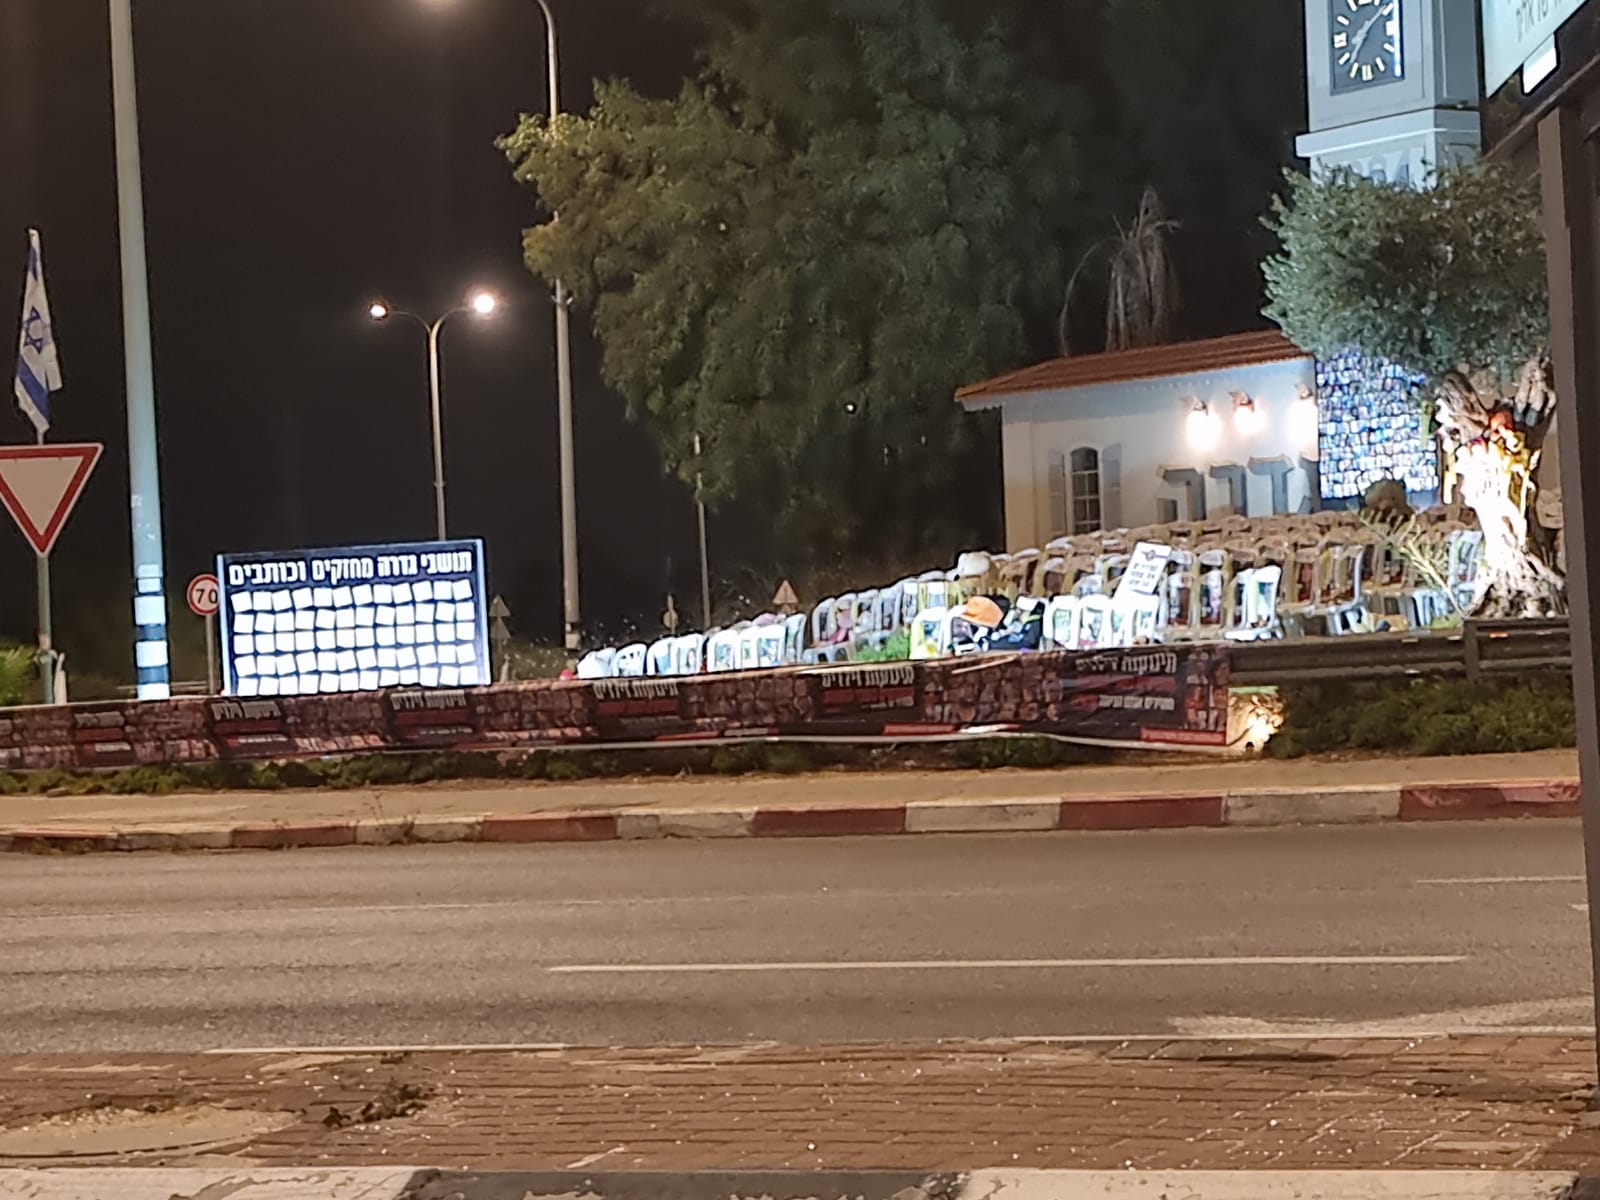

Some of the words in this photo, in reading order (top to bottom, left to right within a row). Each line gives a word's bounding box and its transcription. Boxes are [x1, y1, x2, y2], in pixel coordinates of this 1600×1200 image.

[228, 560, 307, 586] וכותבים
[311, 557, 374, 586] מחזקים
[377, 554, 418, 577] גדרה
[420, 551, 472, 575] תושבי
[195, 588, 218, 604] 70
